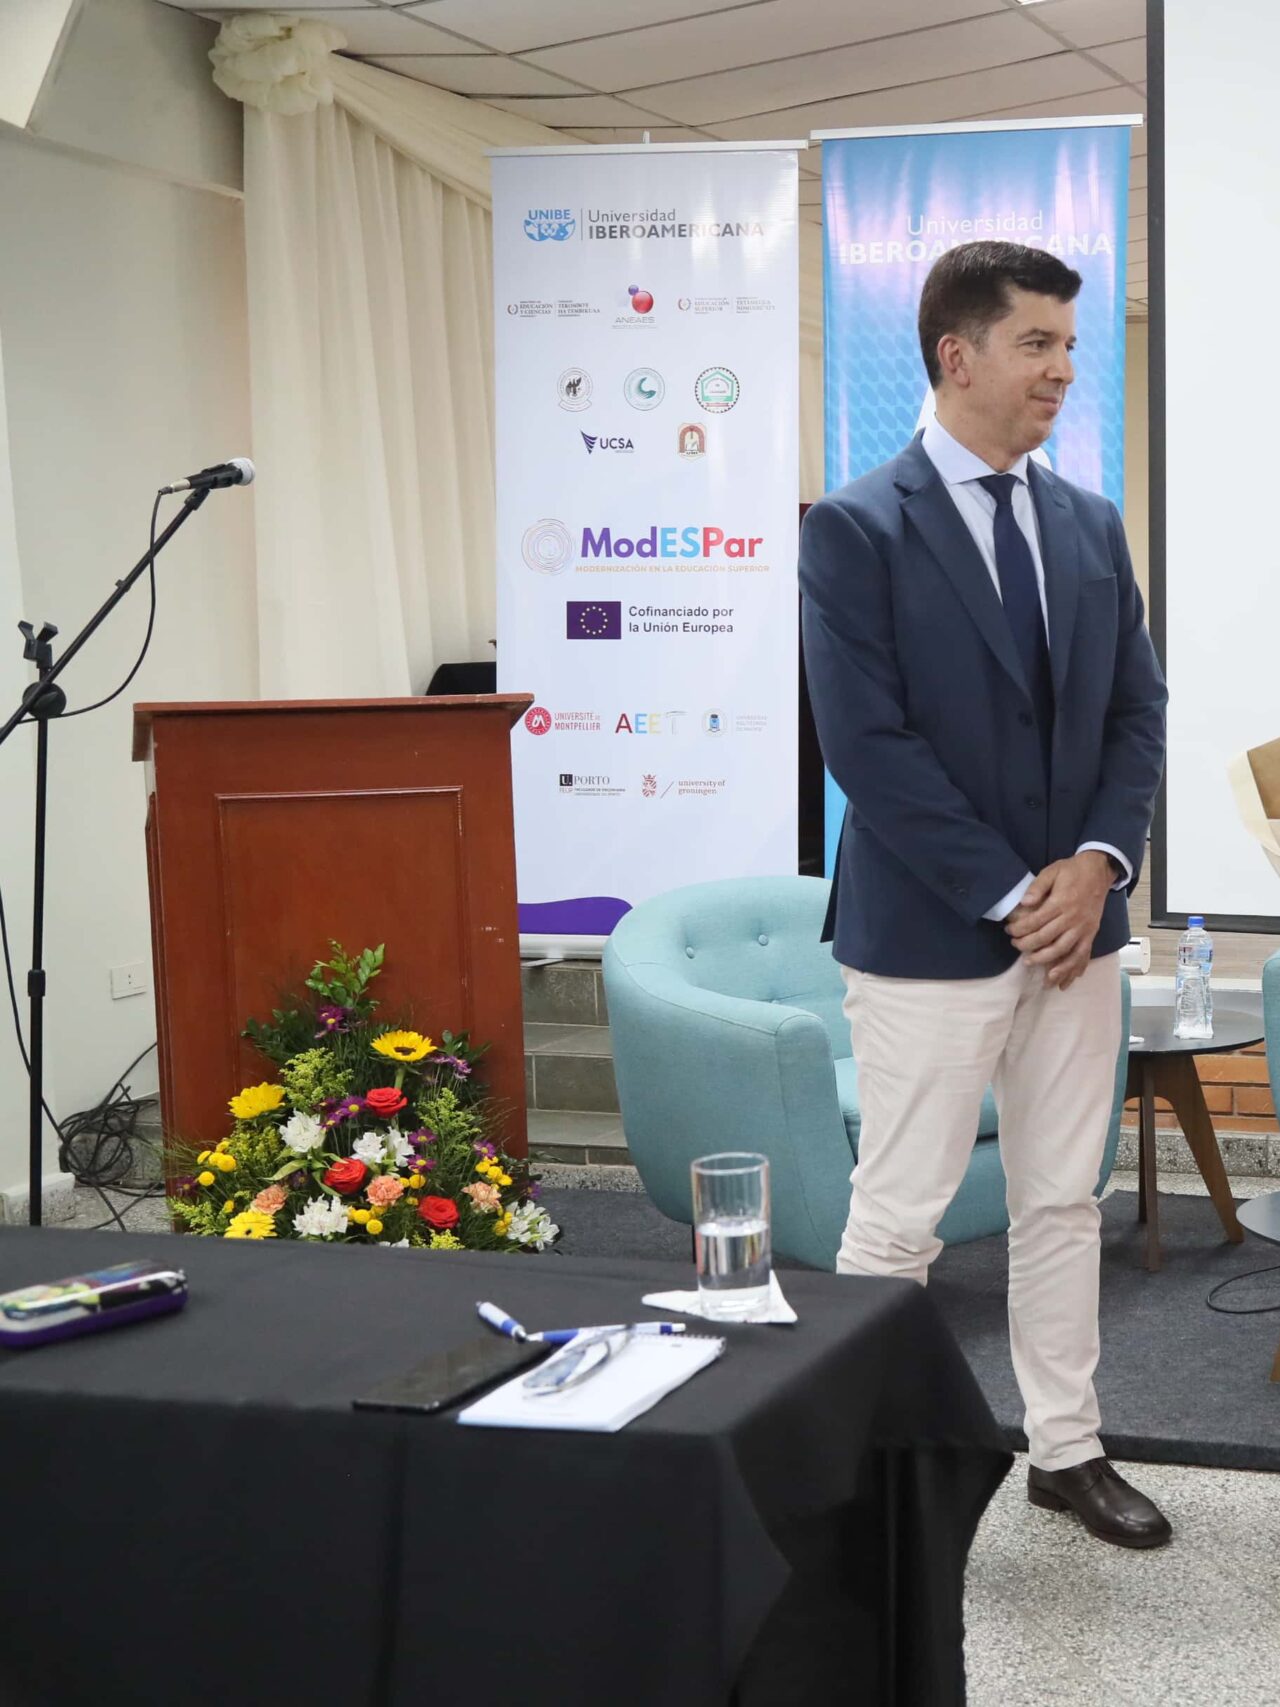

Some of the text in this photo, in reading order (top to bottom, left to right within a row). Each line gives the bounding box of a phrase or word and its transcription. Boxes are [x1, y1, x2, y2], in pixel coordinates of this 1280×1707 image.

[528, 208, 571, 221] UNIBE
[588, 208, 676, 223] Universidad
[907, 210, 1043, 236] Universidad
[588, 223, 765, 240] IBEROAMERICANA
[840, 233, 1113, 266] IBEROACANA
[600, 437, 634, 450] UCSA
[580, 525, 764, 559] ModESPar
[628, 606, 734, 620] Cofinanciado por
[629, 621, 734, 636] la Unión Europea
[554, 722, 601, 731] MONTPELLIER
[574, 775, 610, 786] PORTO
